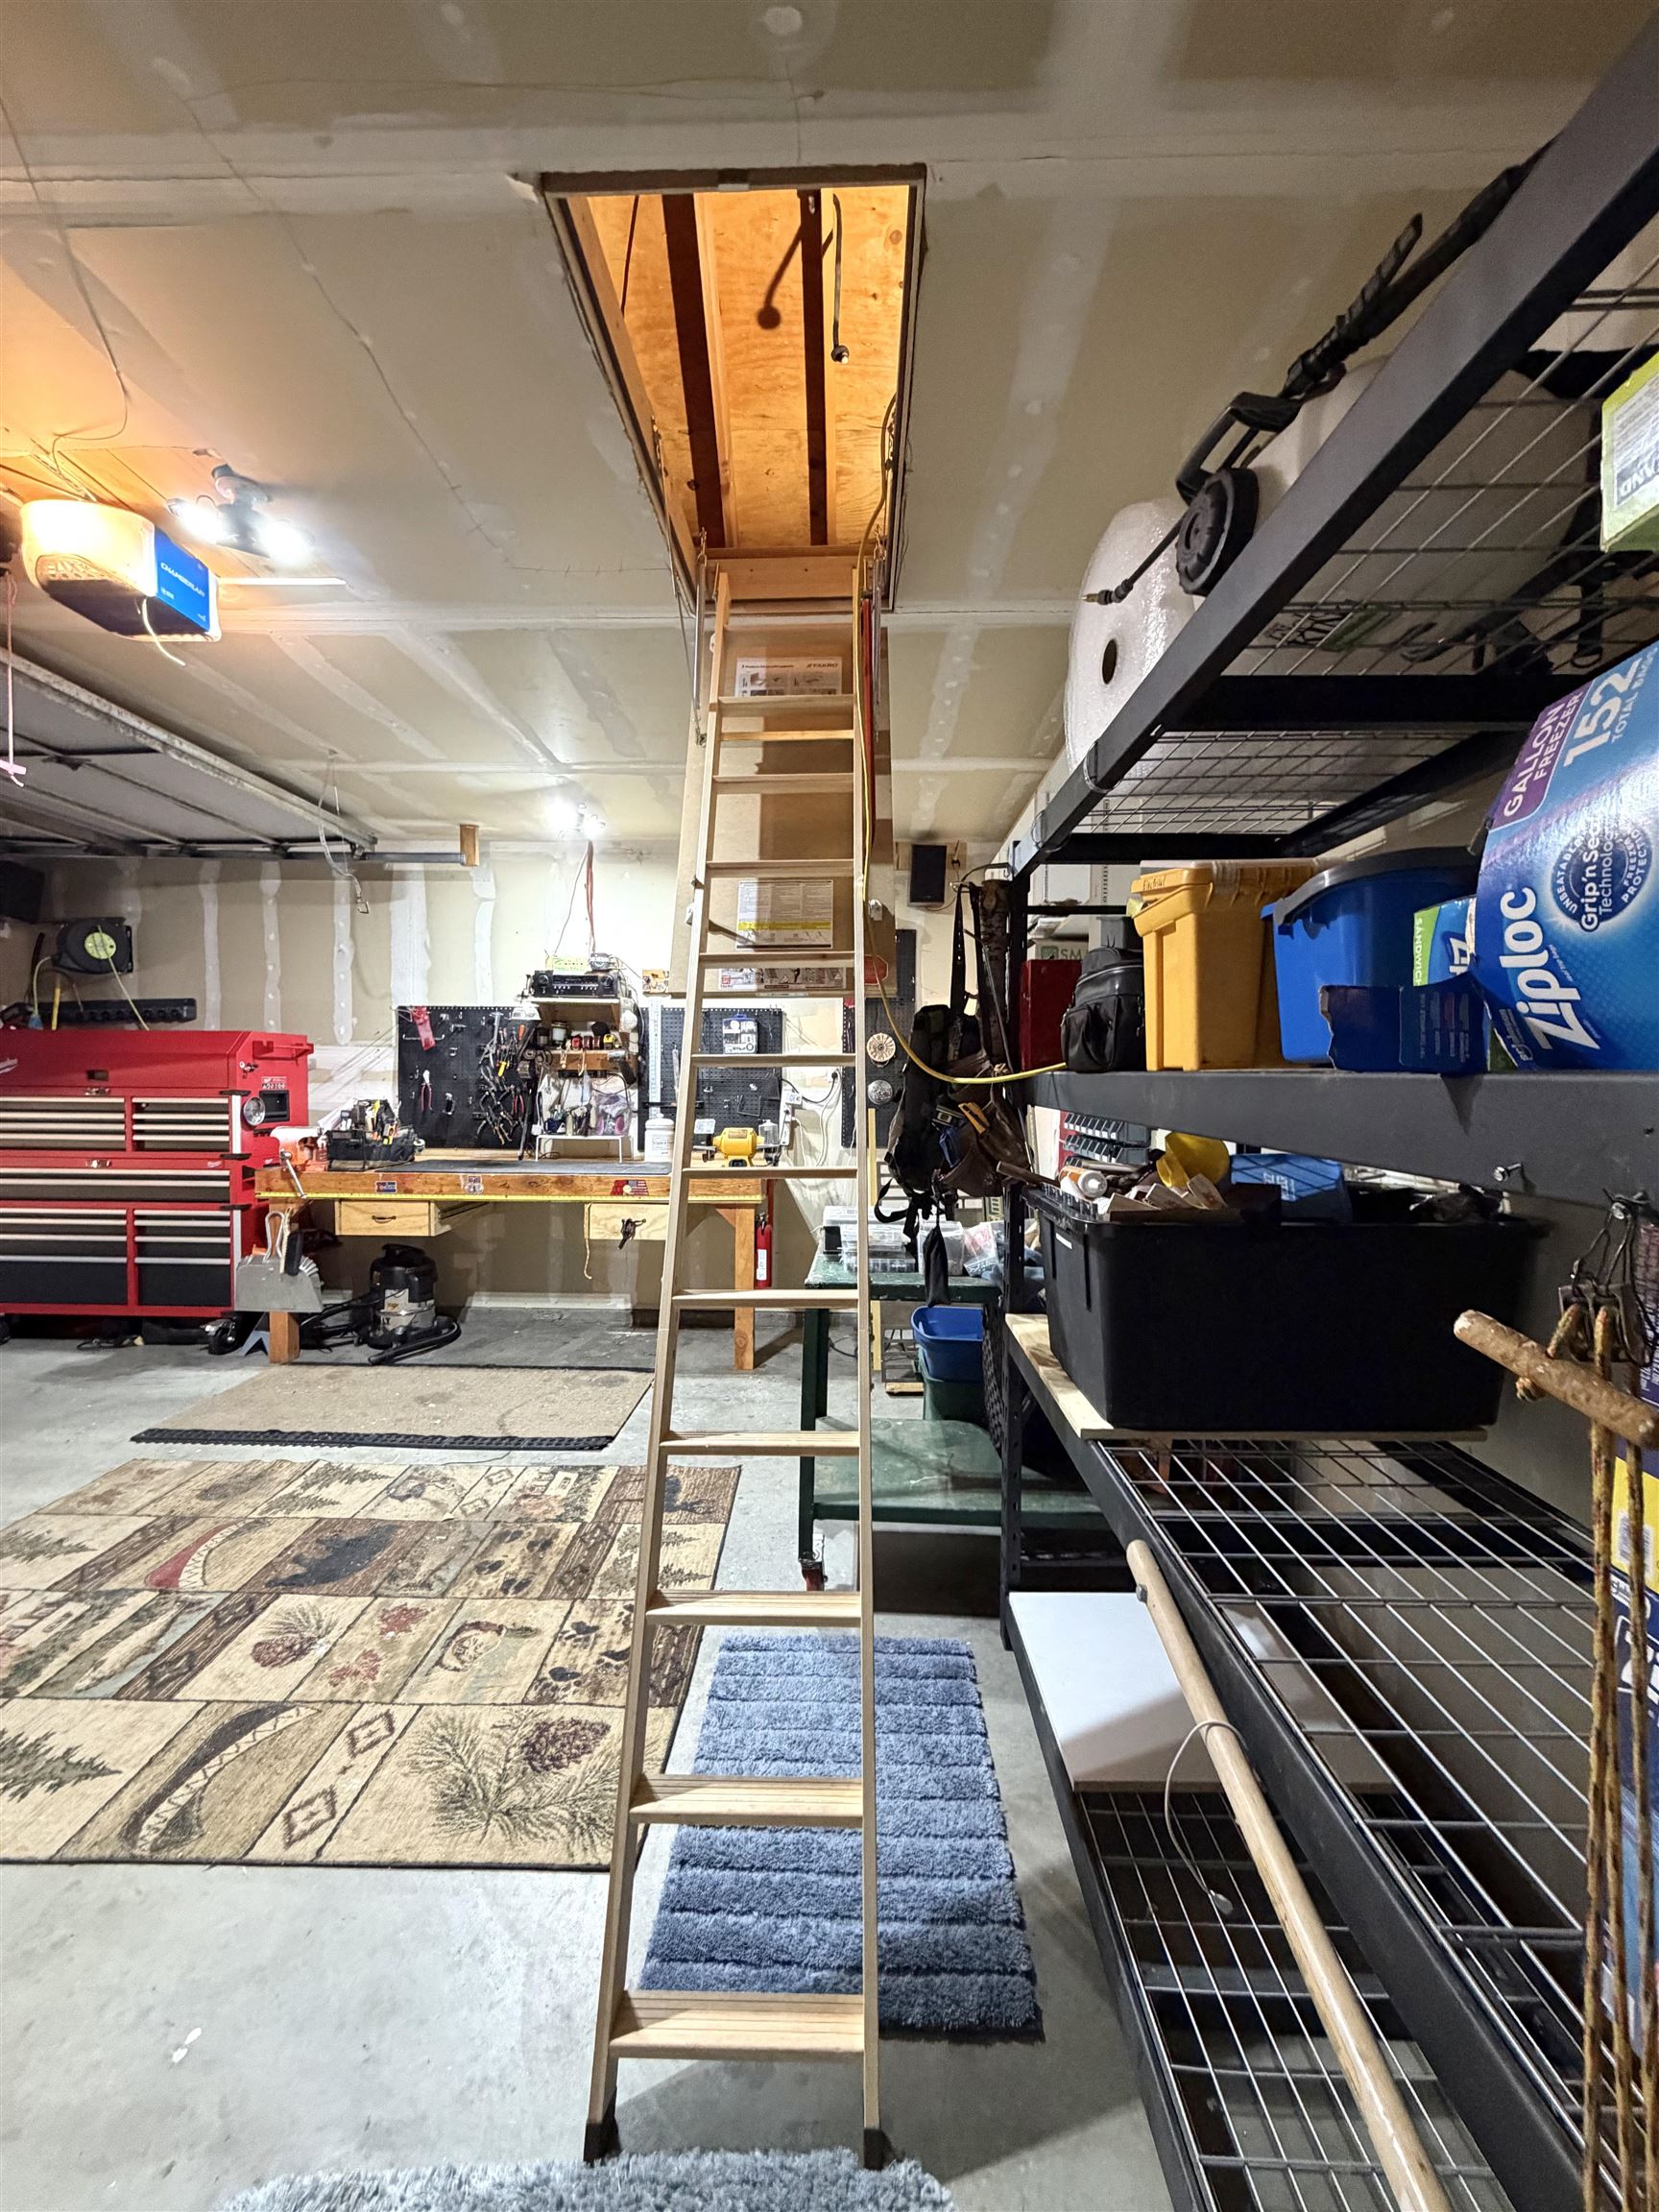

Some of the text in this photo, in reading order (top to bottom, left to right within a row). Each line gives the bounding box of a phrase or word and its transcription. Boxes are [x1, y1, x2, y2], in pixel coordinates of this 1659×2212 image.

[1503, 703, 1566, 816] GALLON
[1533, 691, 1584, 781] FREEZER
[1563, 658, 1643, 767] 152
[1611, 691, 1639, 743] TOTAL
[1580, 865, 1600, 930] Grip'n
[1499, 887, 1600, 1050] Ziploc
